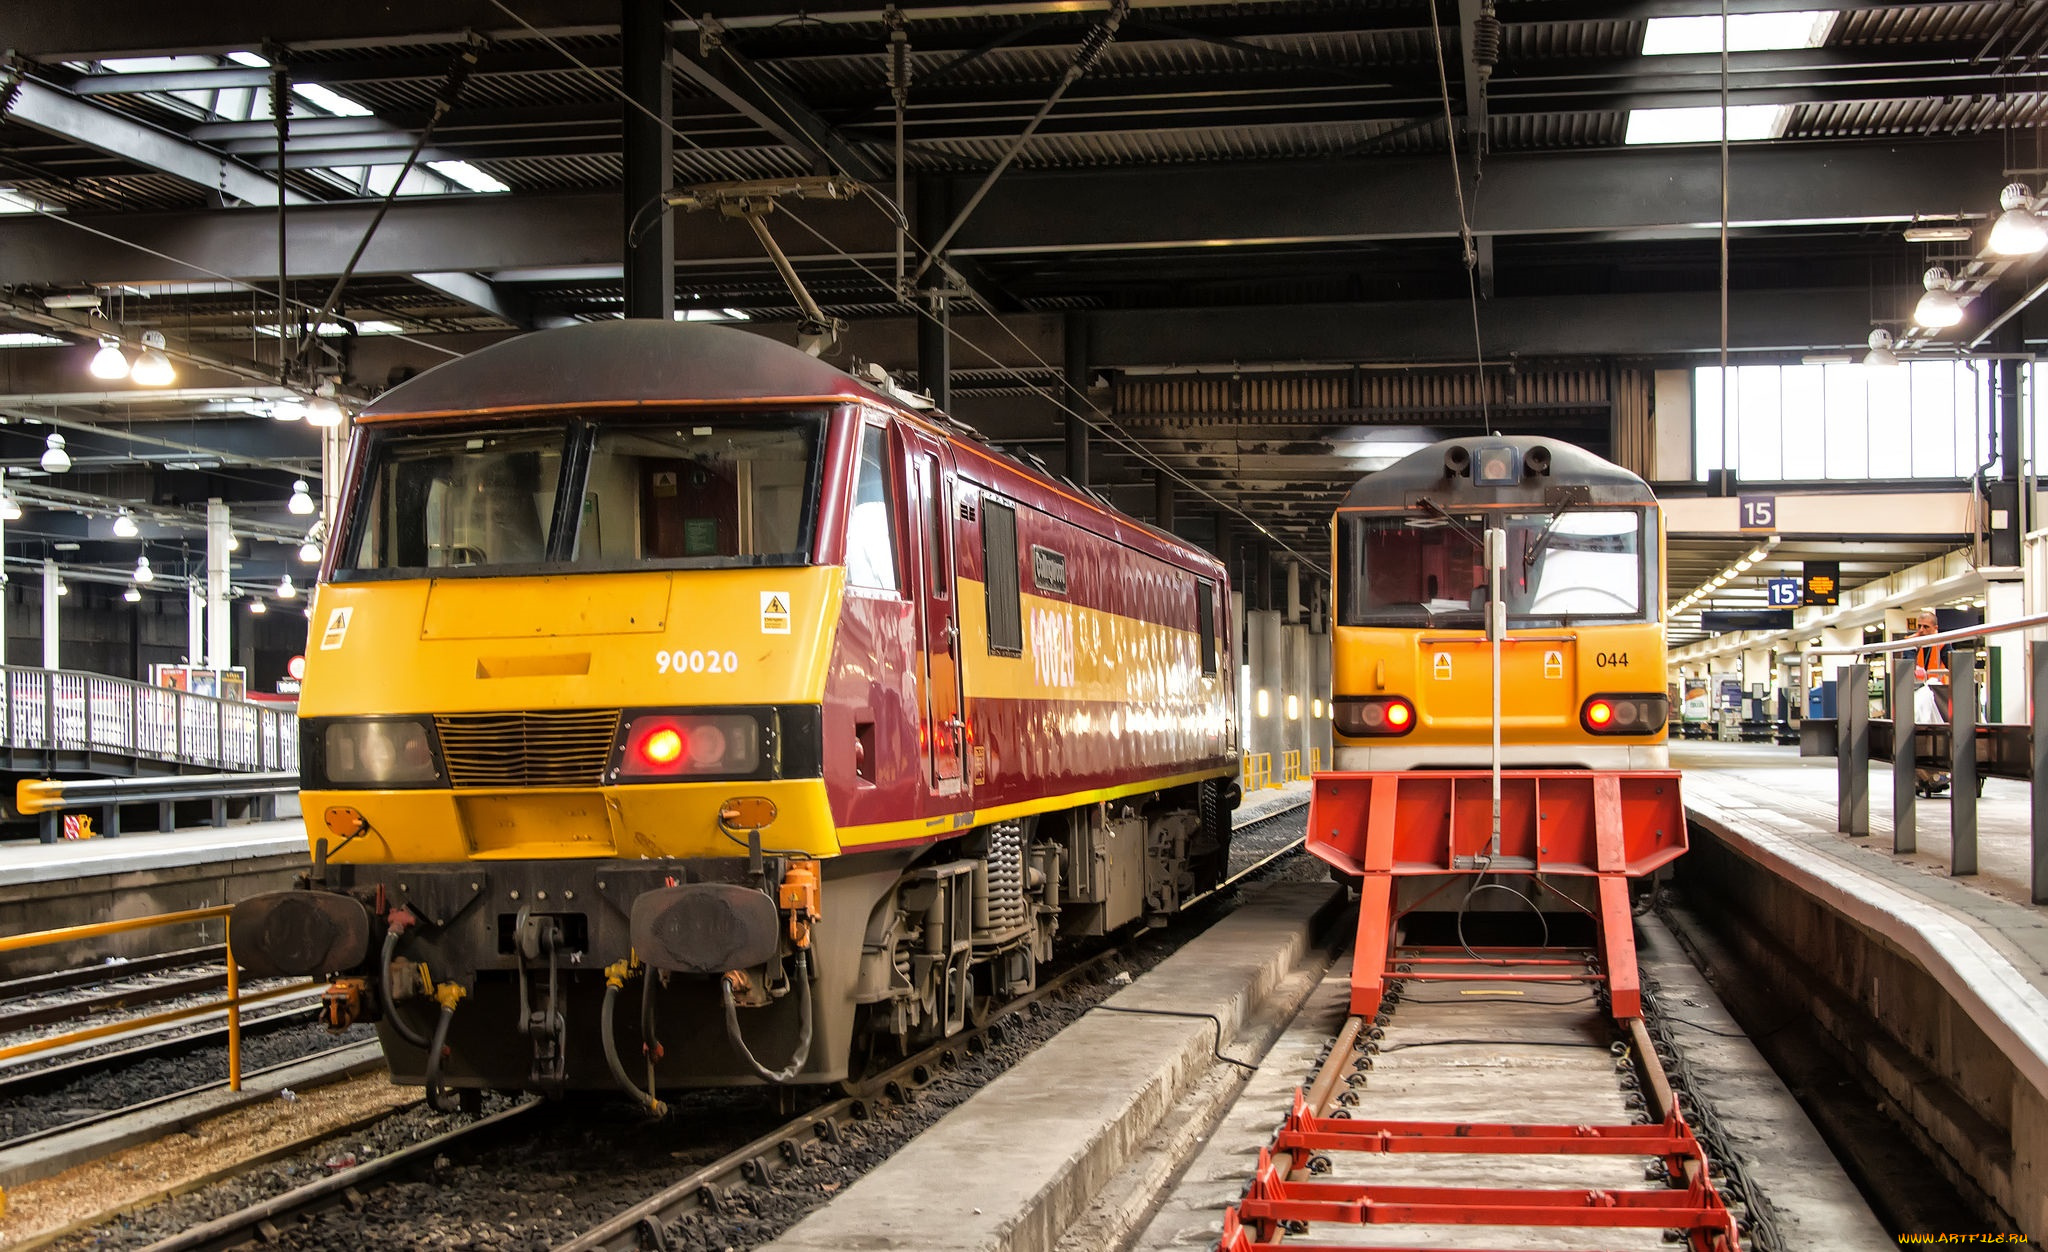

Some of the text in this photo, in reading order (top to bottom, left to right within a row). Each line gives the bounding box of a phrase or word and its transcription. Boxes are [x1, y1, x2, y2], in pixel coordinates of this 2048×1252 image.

[1744, 502, 1771, 525] 15
[1771, 583, 1795, 604] 15
[655, 649, 738, 674] 90020
[1596, 652, 1629, 667] 044
